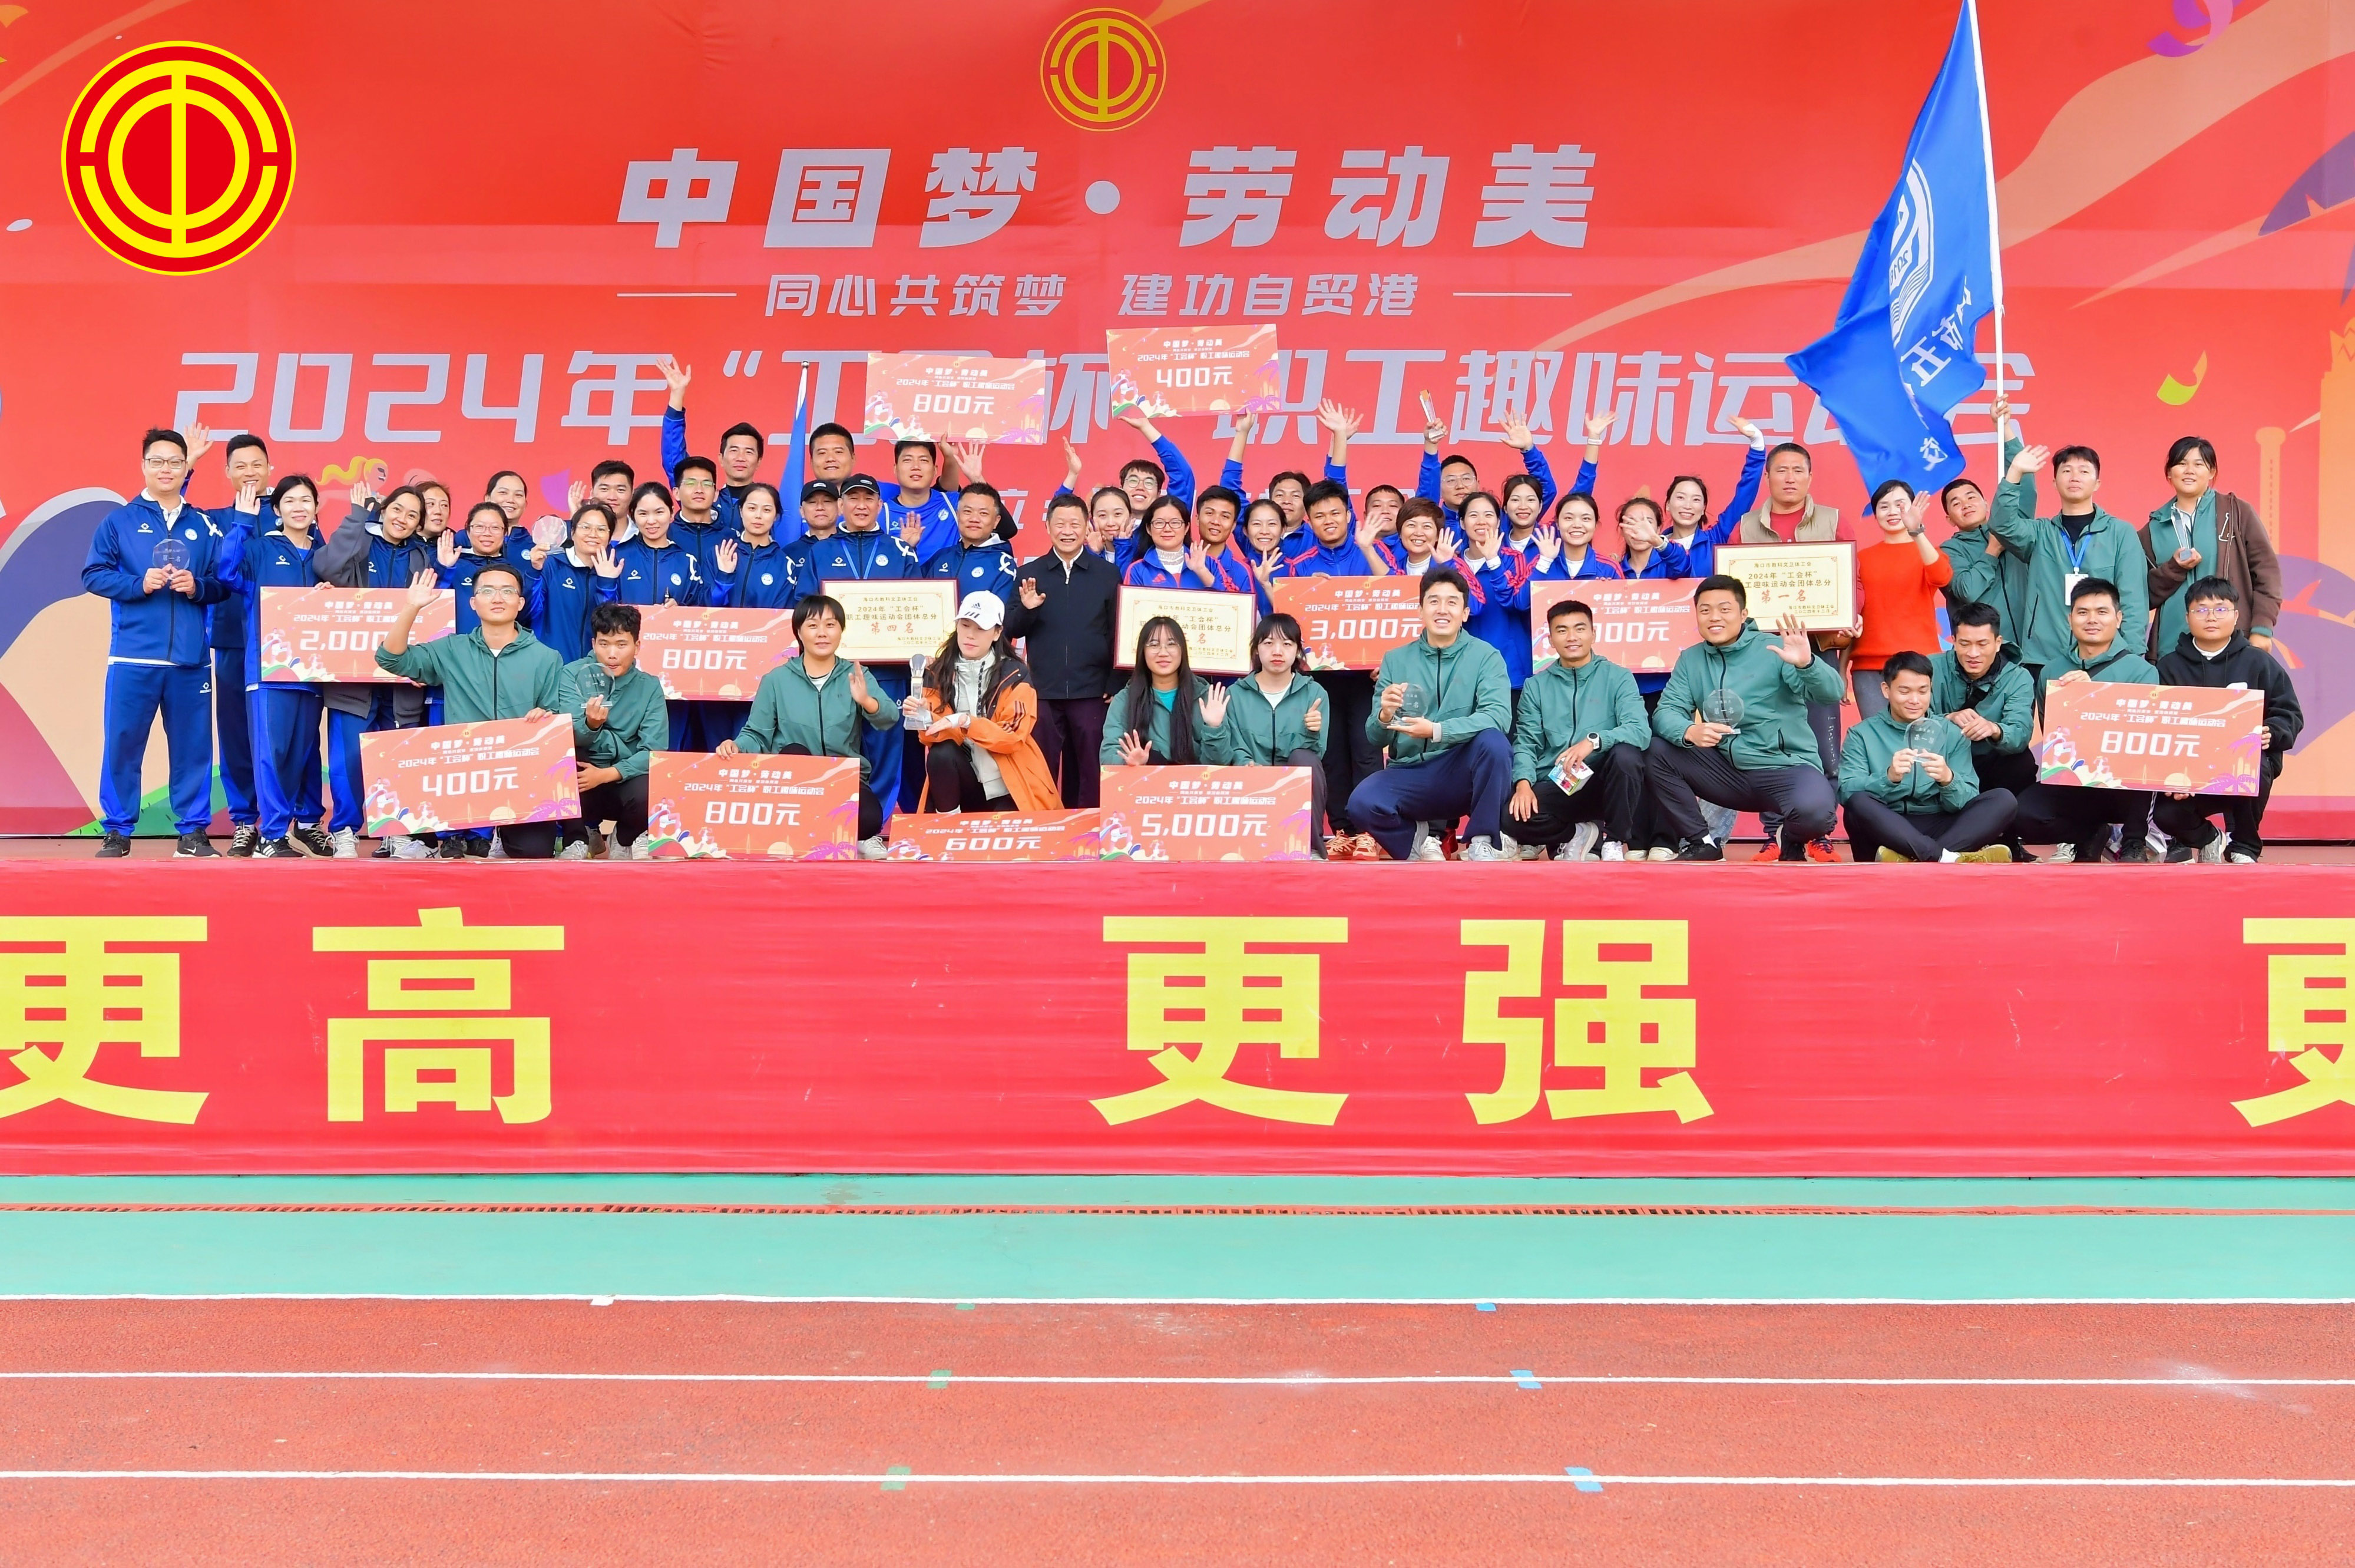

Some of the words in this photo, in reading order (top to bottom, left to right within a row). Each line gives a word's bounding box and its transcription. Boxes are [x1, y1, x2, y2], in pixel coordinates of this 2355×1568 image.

[616, 144, 1597, 249] 中国梦·劳动美
[765, 274, 1065, 316] 同心共筑梦
[1119, 273, 1420, 316] 建功自贸港
[1156, 366, 1233, 388] 400元
[913, 393, 994, 415] 800元
[1744, 579, 1831, 588] 工趣味运动会团体总分
[1761, 589, 1807, 604] 第一名
[871, 622, 914, 634] 第四名
[1309, 618, 1423, 640] 3,000元
[662, 649, 747, 670] 800元
[2101, 731, 2200, 757] 800元
[422, 766, 519, 797] 400元
[704, 801, 801, 826] 800元
[1140, 813, 1267, 837] 5,000元
[945, 836, 1041, 851] 600元
[0, 907, 565, 1124] 更高
[1090, 916, 1714, 1126] 更强
